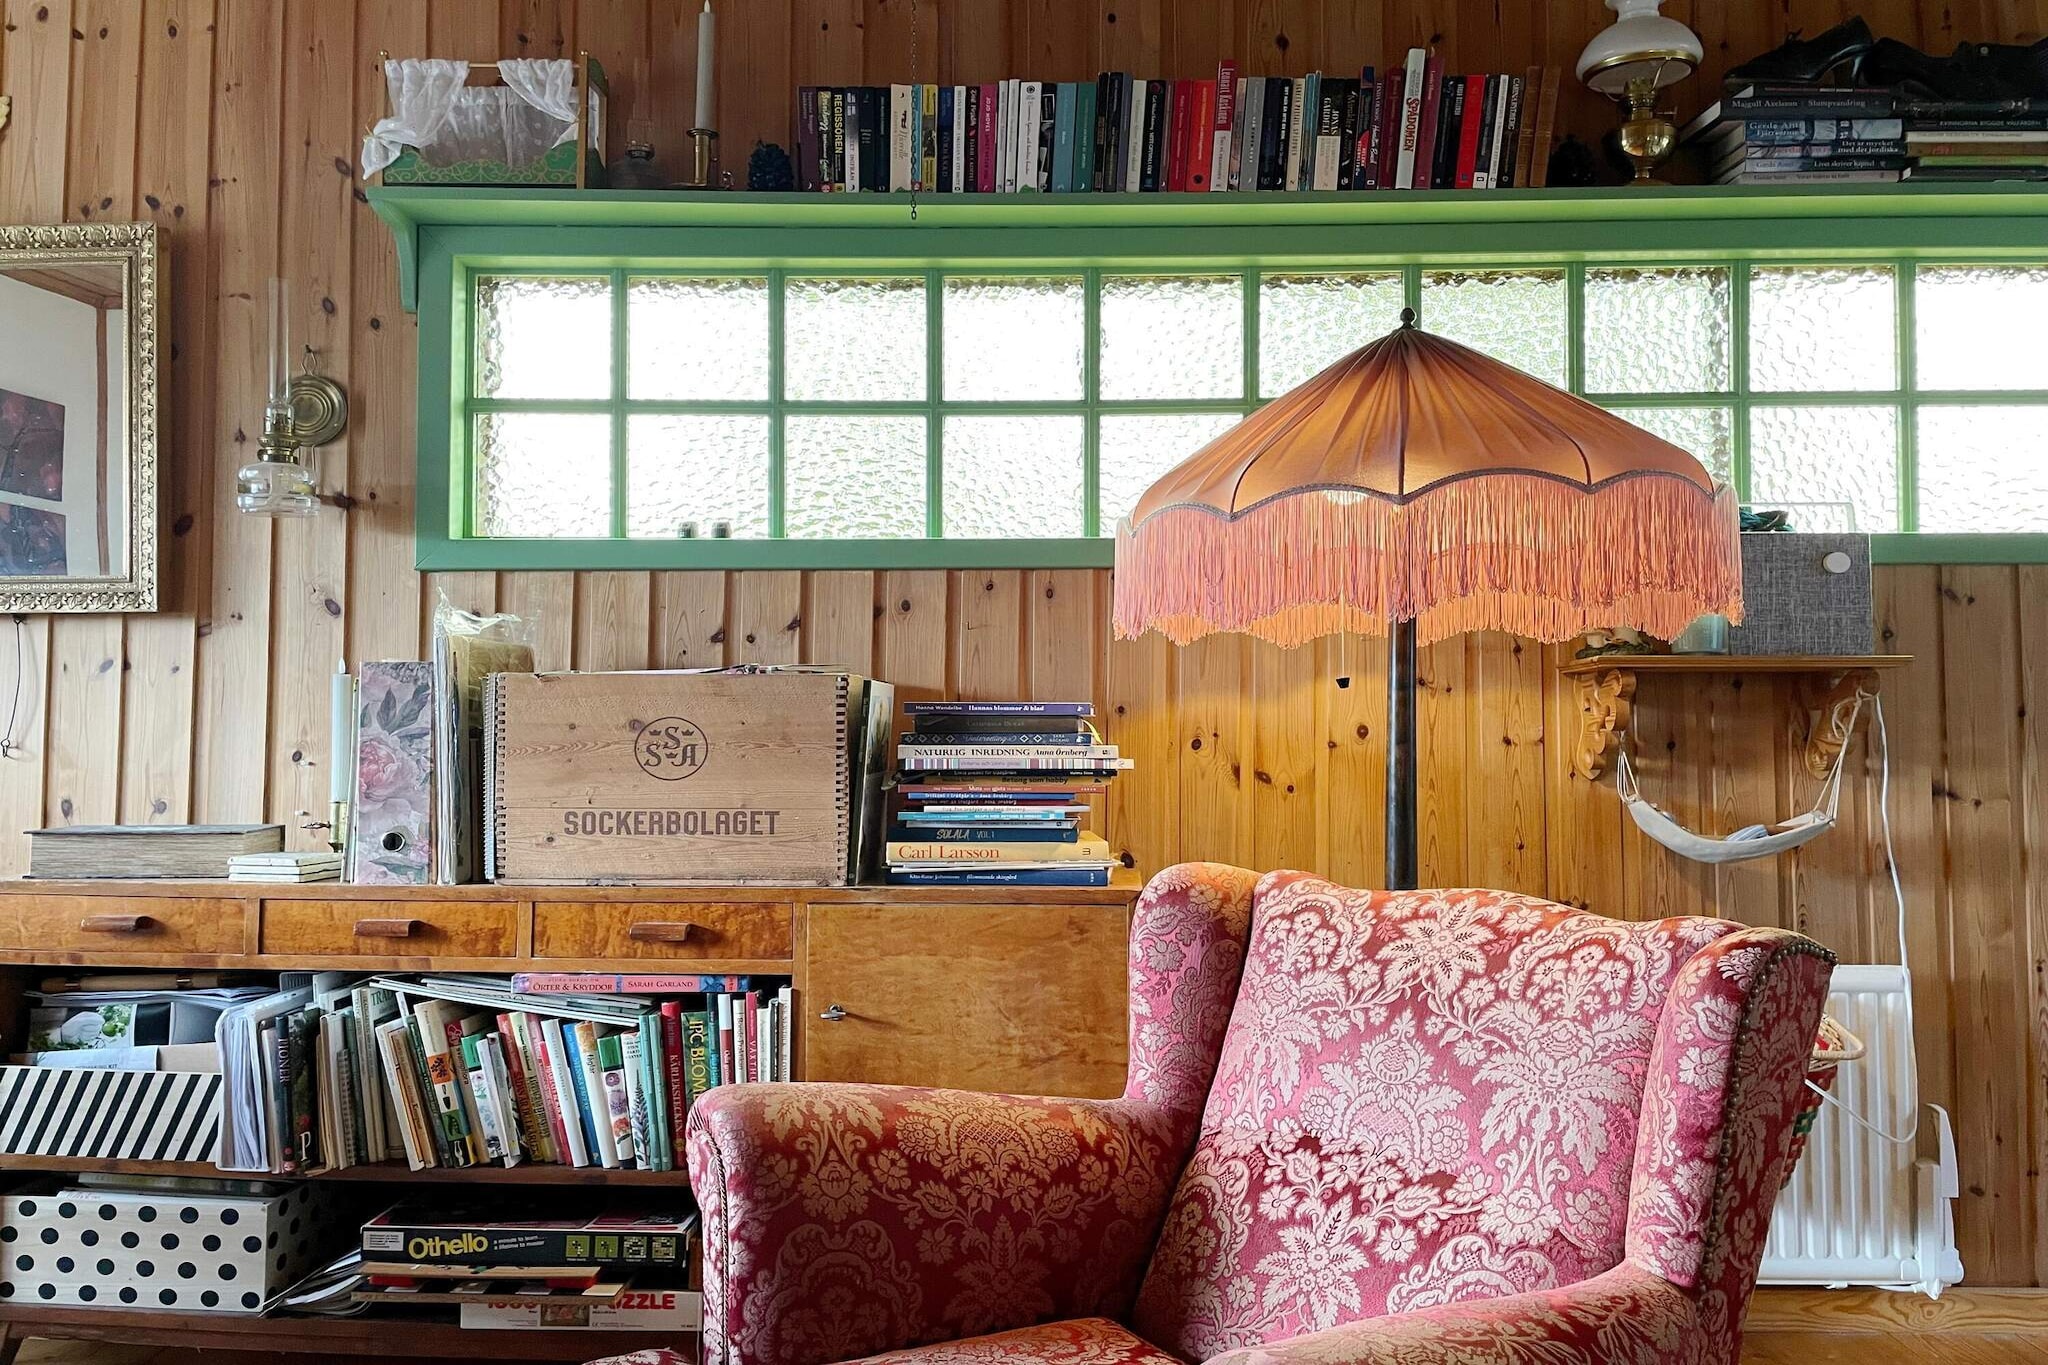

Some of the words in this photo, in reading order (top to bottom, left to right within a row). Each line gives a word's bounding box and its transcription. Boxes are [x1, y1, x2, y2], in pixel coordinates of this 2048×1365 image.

[1219, 68, 1234, 93] Lennart
[1217, 95, 1233, 124] Koskinen
[1731, 99, 1762, 109] Majgull
[1764, 99, 1798, 108] Axelsson
[1808, 99, 1866, 109] Slumpvandring
[834, 94, 844, 153] REGISSÖREN
[1322, 97, 1332, 135] GARDELL
[1331, 109, 1339, 135] JONAS
[915, 748, 966, 756] NATURLIG
[971, 748, 1030, 756] INREDNING
[1054, 747, 1087, 757] Örnberg
[1045, 776, 1068, 784] hobby
[564, 811, 781, 835] SOCKERBOLAGET
[936, 829, 969, 840] SOLALA
[899, 845, 932, 859] Carl
[939, 845, 999, 859] Larsson
[533, 981, 560, 991] ÖRTER
[562, 983, 569, 991] &
[572, 982, 613, 991] KRYDDOR
[628, 980, 654, 988] SARAH
[656, 980, 693, 988] GARLAND
[669, 1054, 682, 1133] KÄRLEKSTECKEN
[408, 1232, 488, 1260] Othello
[592, 1293, 675, 1310] UZZLE
